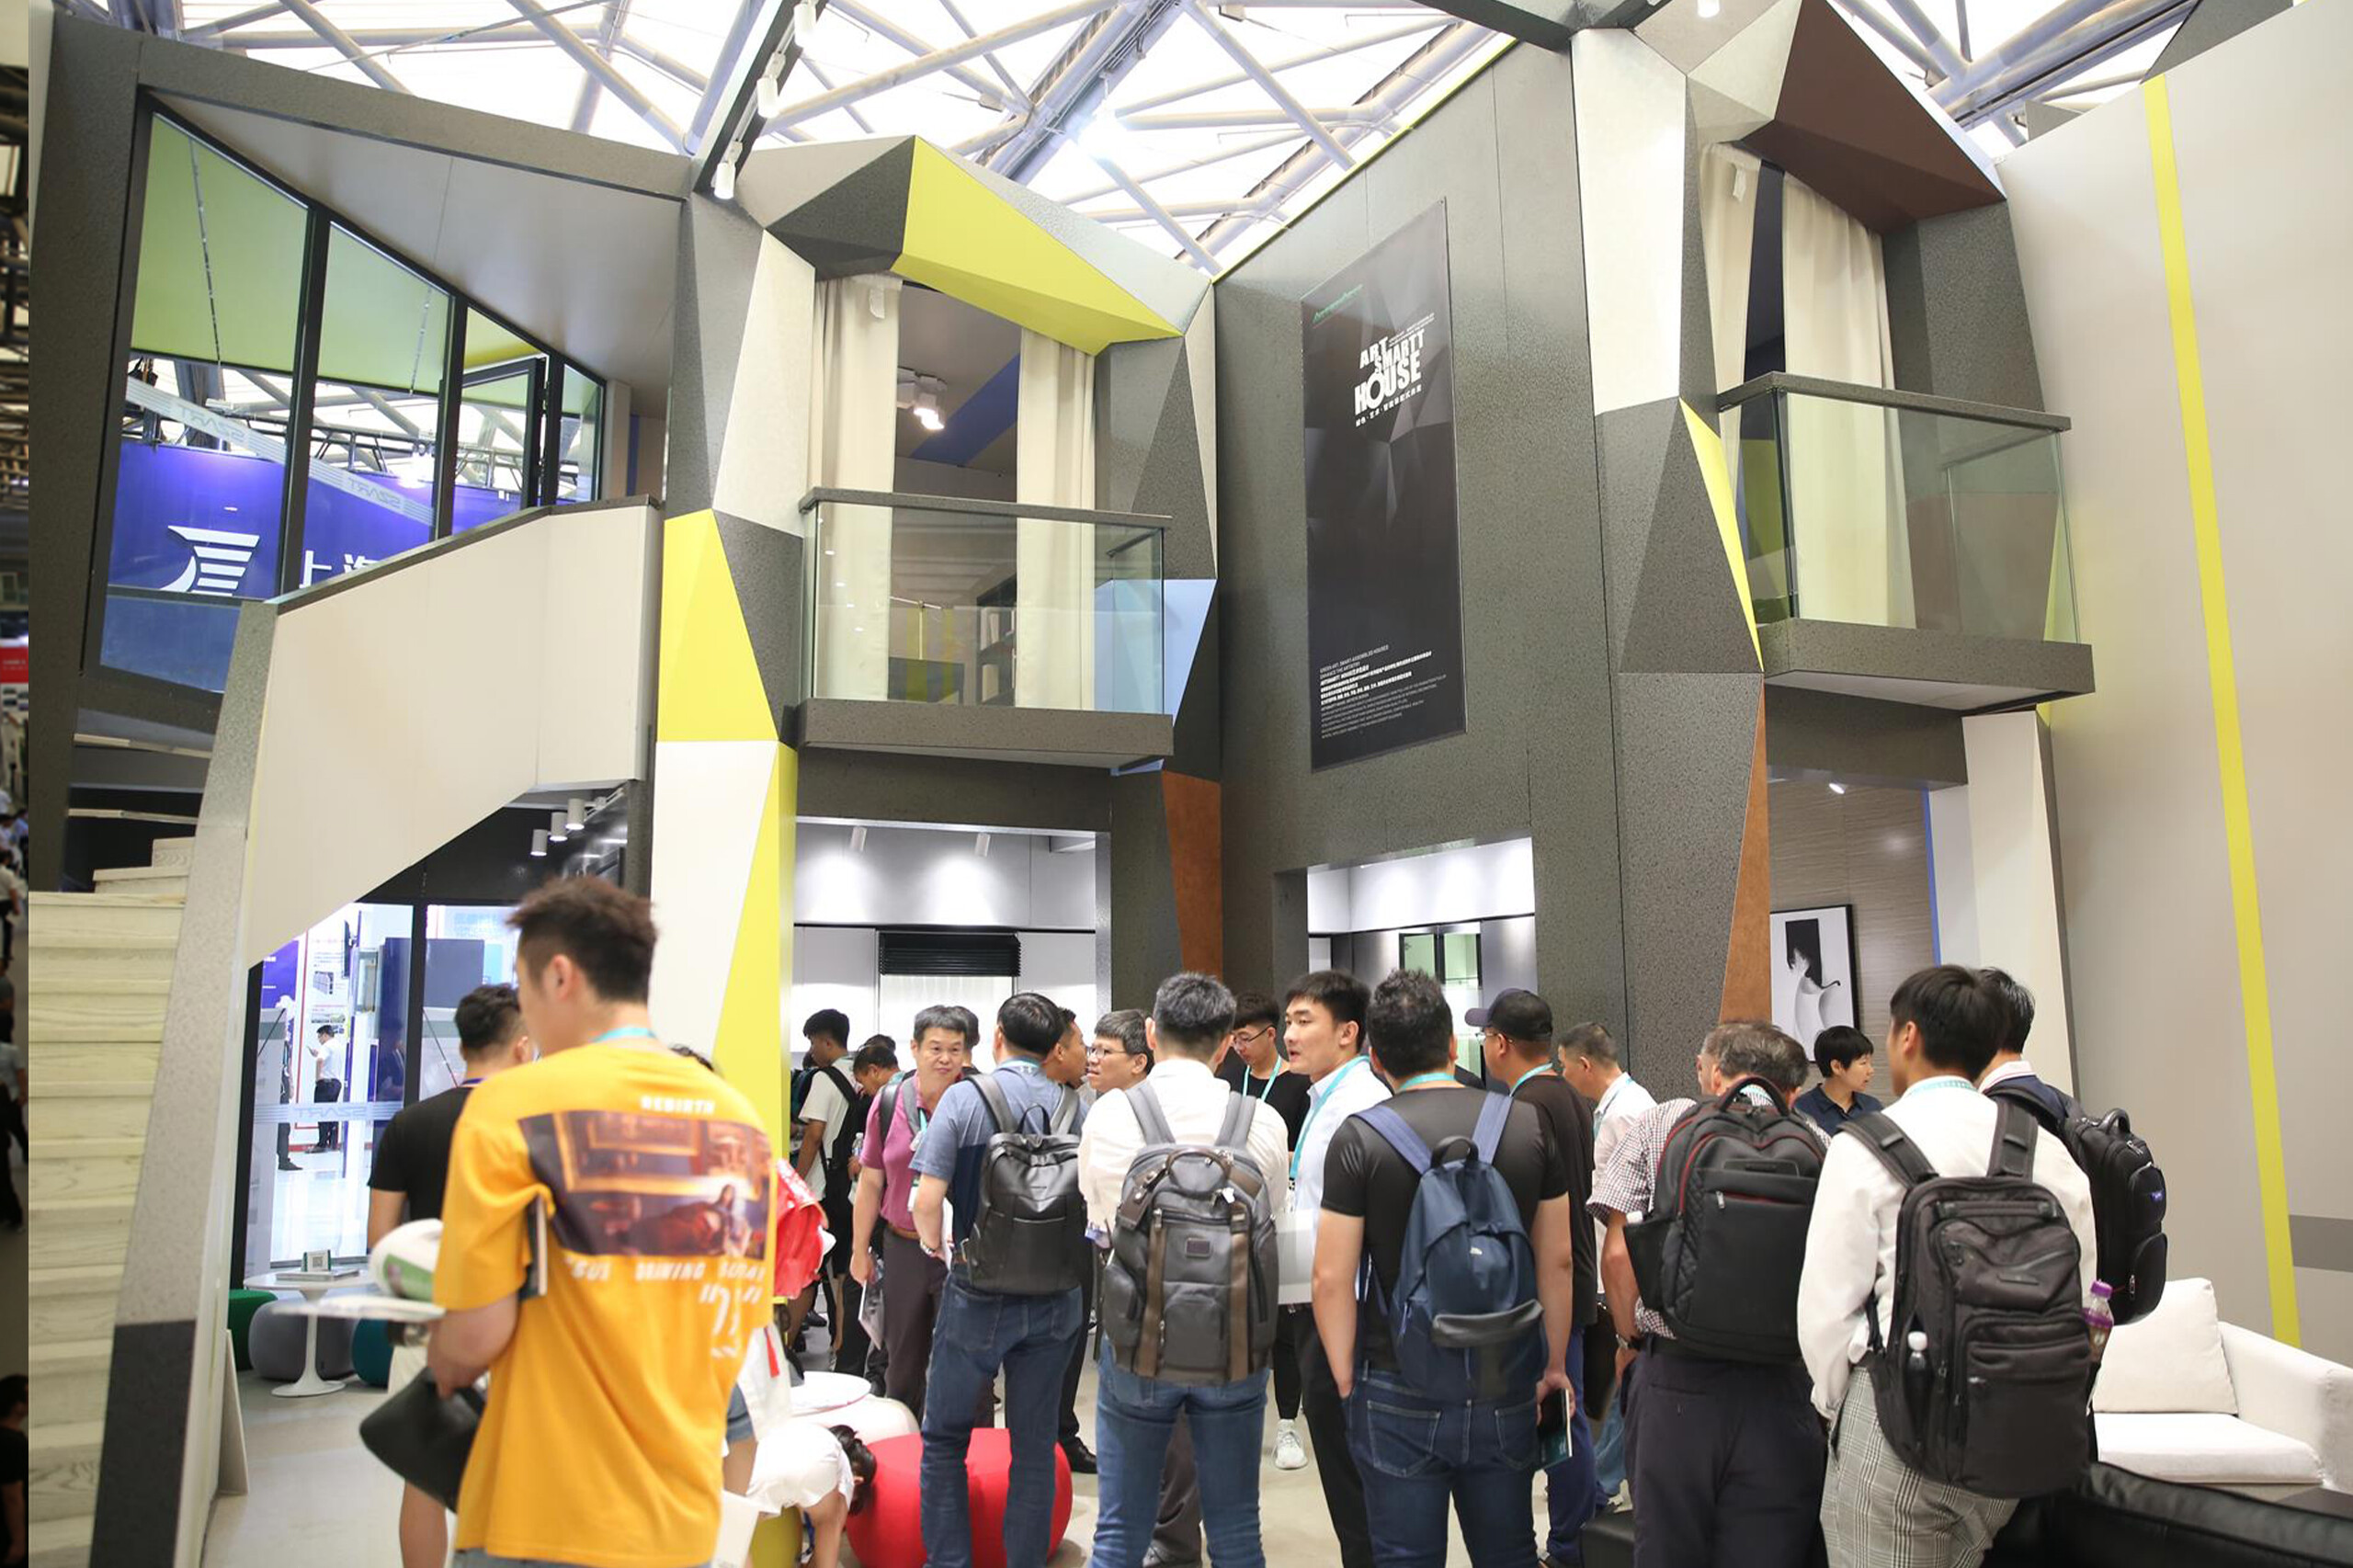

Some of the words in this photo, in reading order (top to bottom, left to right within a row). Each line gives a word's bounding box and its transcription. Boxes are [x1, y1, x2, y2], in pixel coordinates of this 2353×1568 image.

[1359, 336, 1388, 369] ART
[1355, 349, 1422, 415] HOUSE
[299, 550, 380, 589] 上
